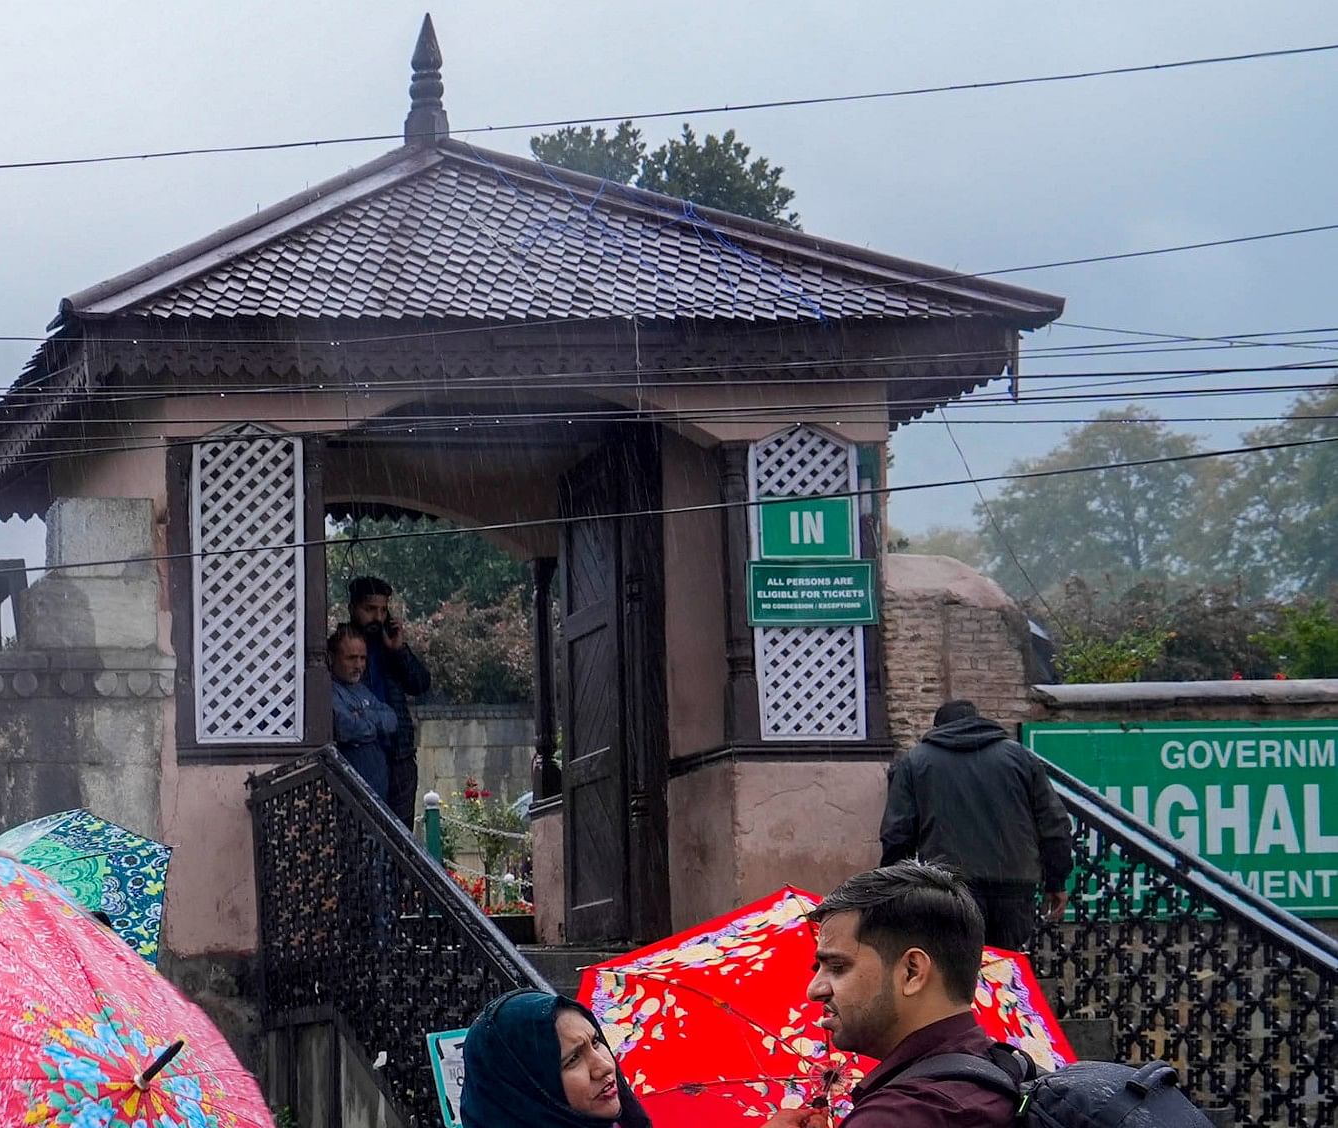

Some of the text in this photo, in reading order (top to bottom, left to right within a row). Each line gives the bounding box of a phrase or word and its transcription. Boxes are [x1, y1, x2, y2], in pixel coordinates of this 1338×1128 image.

[789, 511, 825, 545] IN
[767, 577, 854, 586] ALL PERSONS ARE
[757, 589, 865, 599] ELIGIBLE FOR TICKETS
[1160, 739, 1335, 769] GOVERNM
